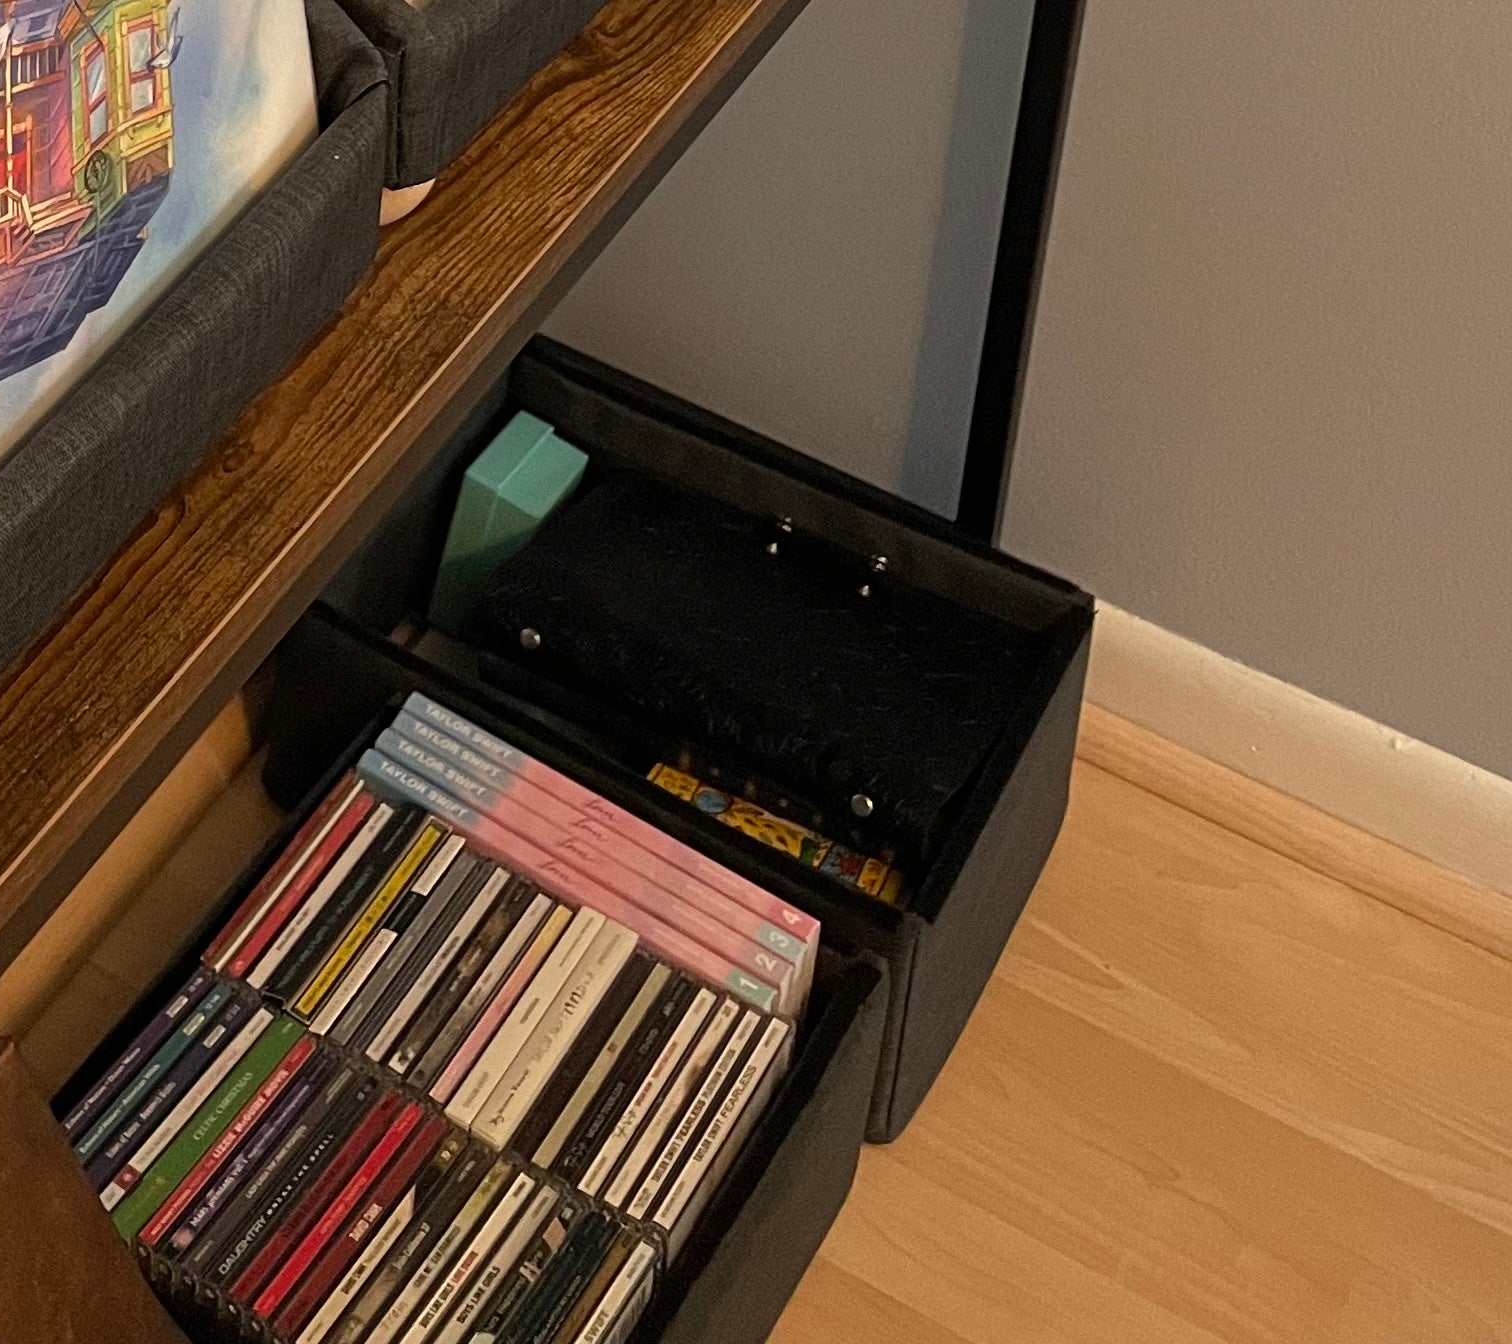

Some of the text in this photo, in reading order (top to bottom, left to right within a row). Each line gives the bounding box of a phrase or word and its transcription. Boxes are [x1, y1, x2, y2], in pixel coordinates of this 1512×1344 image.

[398, 739, 487, 797] TAYLOR SWIFT
[414, 721, 502, 778] TAYLOR SWIFT
[381, 761, 469, 817] TAYLOR SWIFT
[755, 953, 778, 971] 2
[769, 932, 788, 948] 3
[739, 977, 758, 990] 1
[190, 1069, 257, 1142] CELTIC CHRISTMAS
[711, 1063, 764, 1119] FEARLESS
[669, 1097, 712, 1142] FEARLESS
[208, 1215, 277, 1275] DAUGHTRY
[452, 1263, 506, 1325] BOYS LIKE GIRLS
